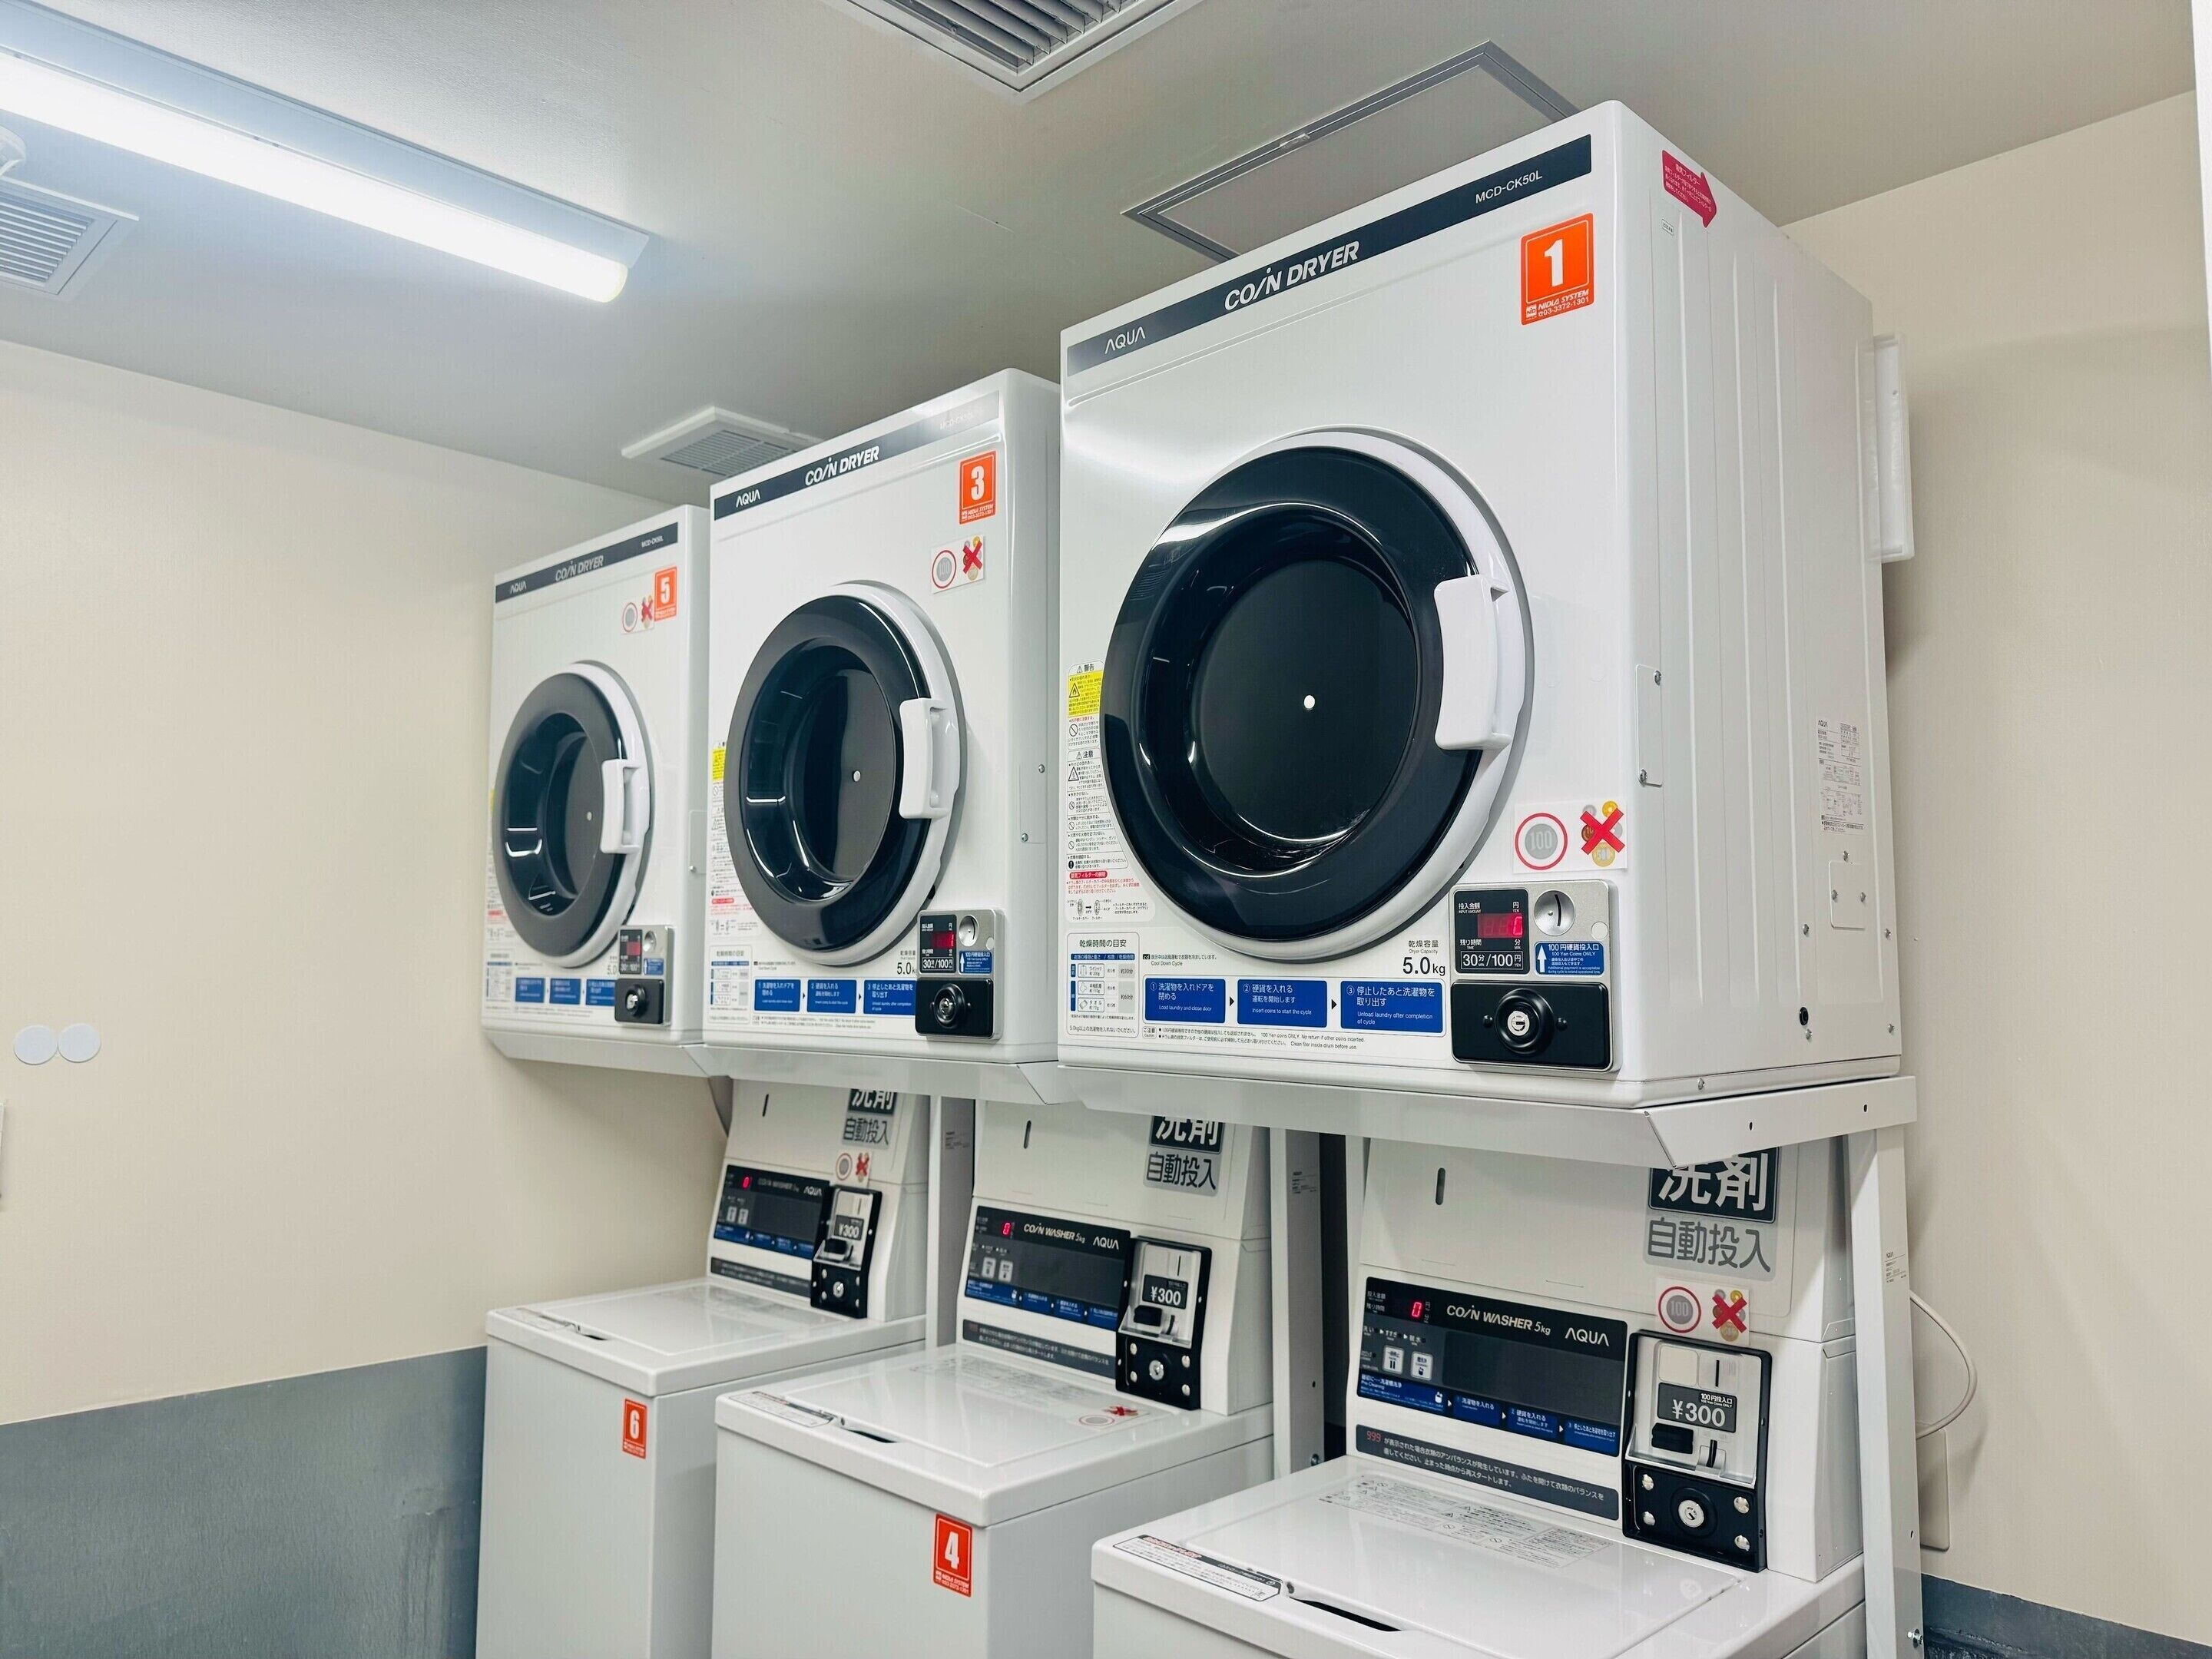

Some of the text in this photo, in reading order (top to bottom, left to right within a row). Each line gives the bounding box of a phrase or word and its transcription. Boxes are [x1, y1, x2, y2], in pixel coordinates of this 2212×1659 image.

[1475, 170, 1543, 204] MCD-CK50L
[1544, 238, 1564, 287] 1
[1224, 240, 1360, 311] COIN DRYER
[1561, 288, 1590, 303] SYSTEM
[1104, 326, 1146, 354] AQUA
[839, 445, 880, 474] DRYER
[971, 465, 985, 501] 3
[735, 488, 761, 508] AQUA
[578, 555, 604, 575] DRYER
[509, 581, 527, 594] AQUA
[660, 576, 671, 604] 5
[1079, 939, 1127, 948] 乾燥時間の目安
[1408, 939, 1439, 948] 乾燥容量
[1158, 982, 1214, 992] 洗濯物を入れドアを
[1158, 992, 1177, 1001] 閉める
[1252, 984, 1293, 993] 硬貨を入れる
[1356, 987, 1435, 998] 停止したあと洗濯物を
[1252, 995, 1296, 1004] 運転を開始します
[1356, 997, 1387, 1007] 取り出す
[843, 1116, 889, 1145] 自動投入
[1147, 1151, 1216, 1190] 自動投入
[803, 1186, 823, 1197] AQUA
[1657, 1153, 1768, 1211] 洗剤
[1002, 1222, 1011, 1235] 0
[1045, 1227, 1075, 1240] WASHER
[1092, 1236, 1120, 1250] AQUA
[1647, 1217, 1771, 1273] 自動投入
[1150, 1286, 1181, 1306] ¥300
[1412, 1301, 1422, 1317] 0
[1482, 1311, 1533, 1330] WASHER
[1534, 1321, 1551, 1336] 5kg
[1565, 1327, 1610, 1346] AQUA
[1516, 1409, 1546, 1422] 硬貨を入れる
[1672, 1399, 1726, 1427] ¥300
[630, 1409, 640, 1440] 6
[1366, 1430, 1382, 1443] 999
[944, 1530, 960, 1571] 4
